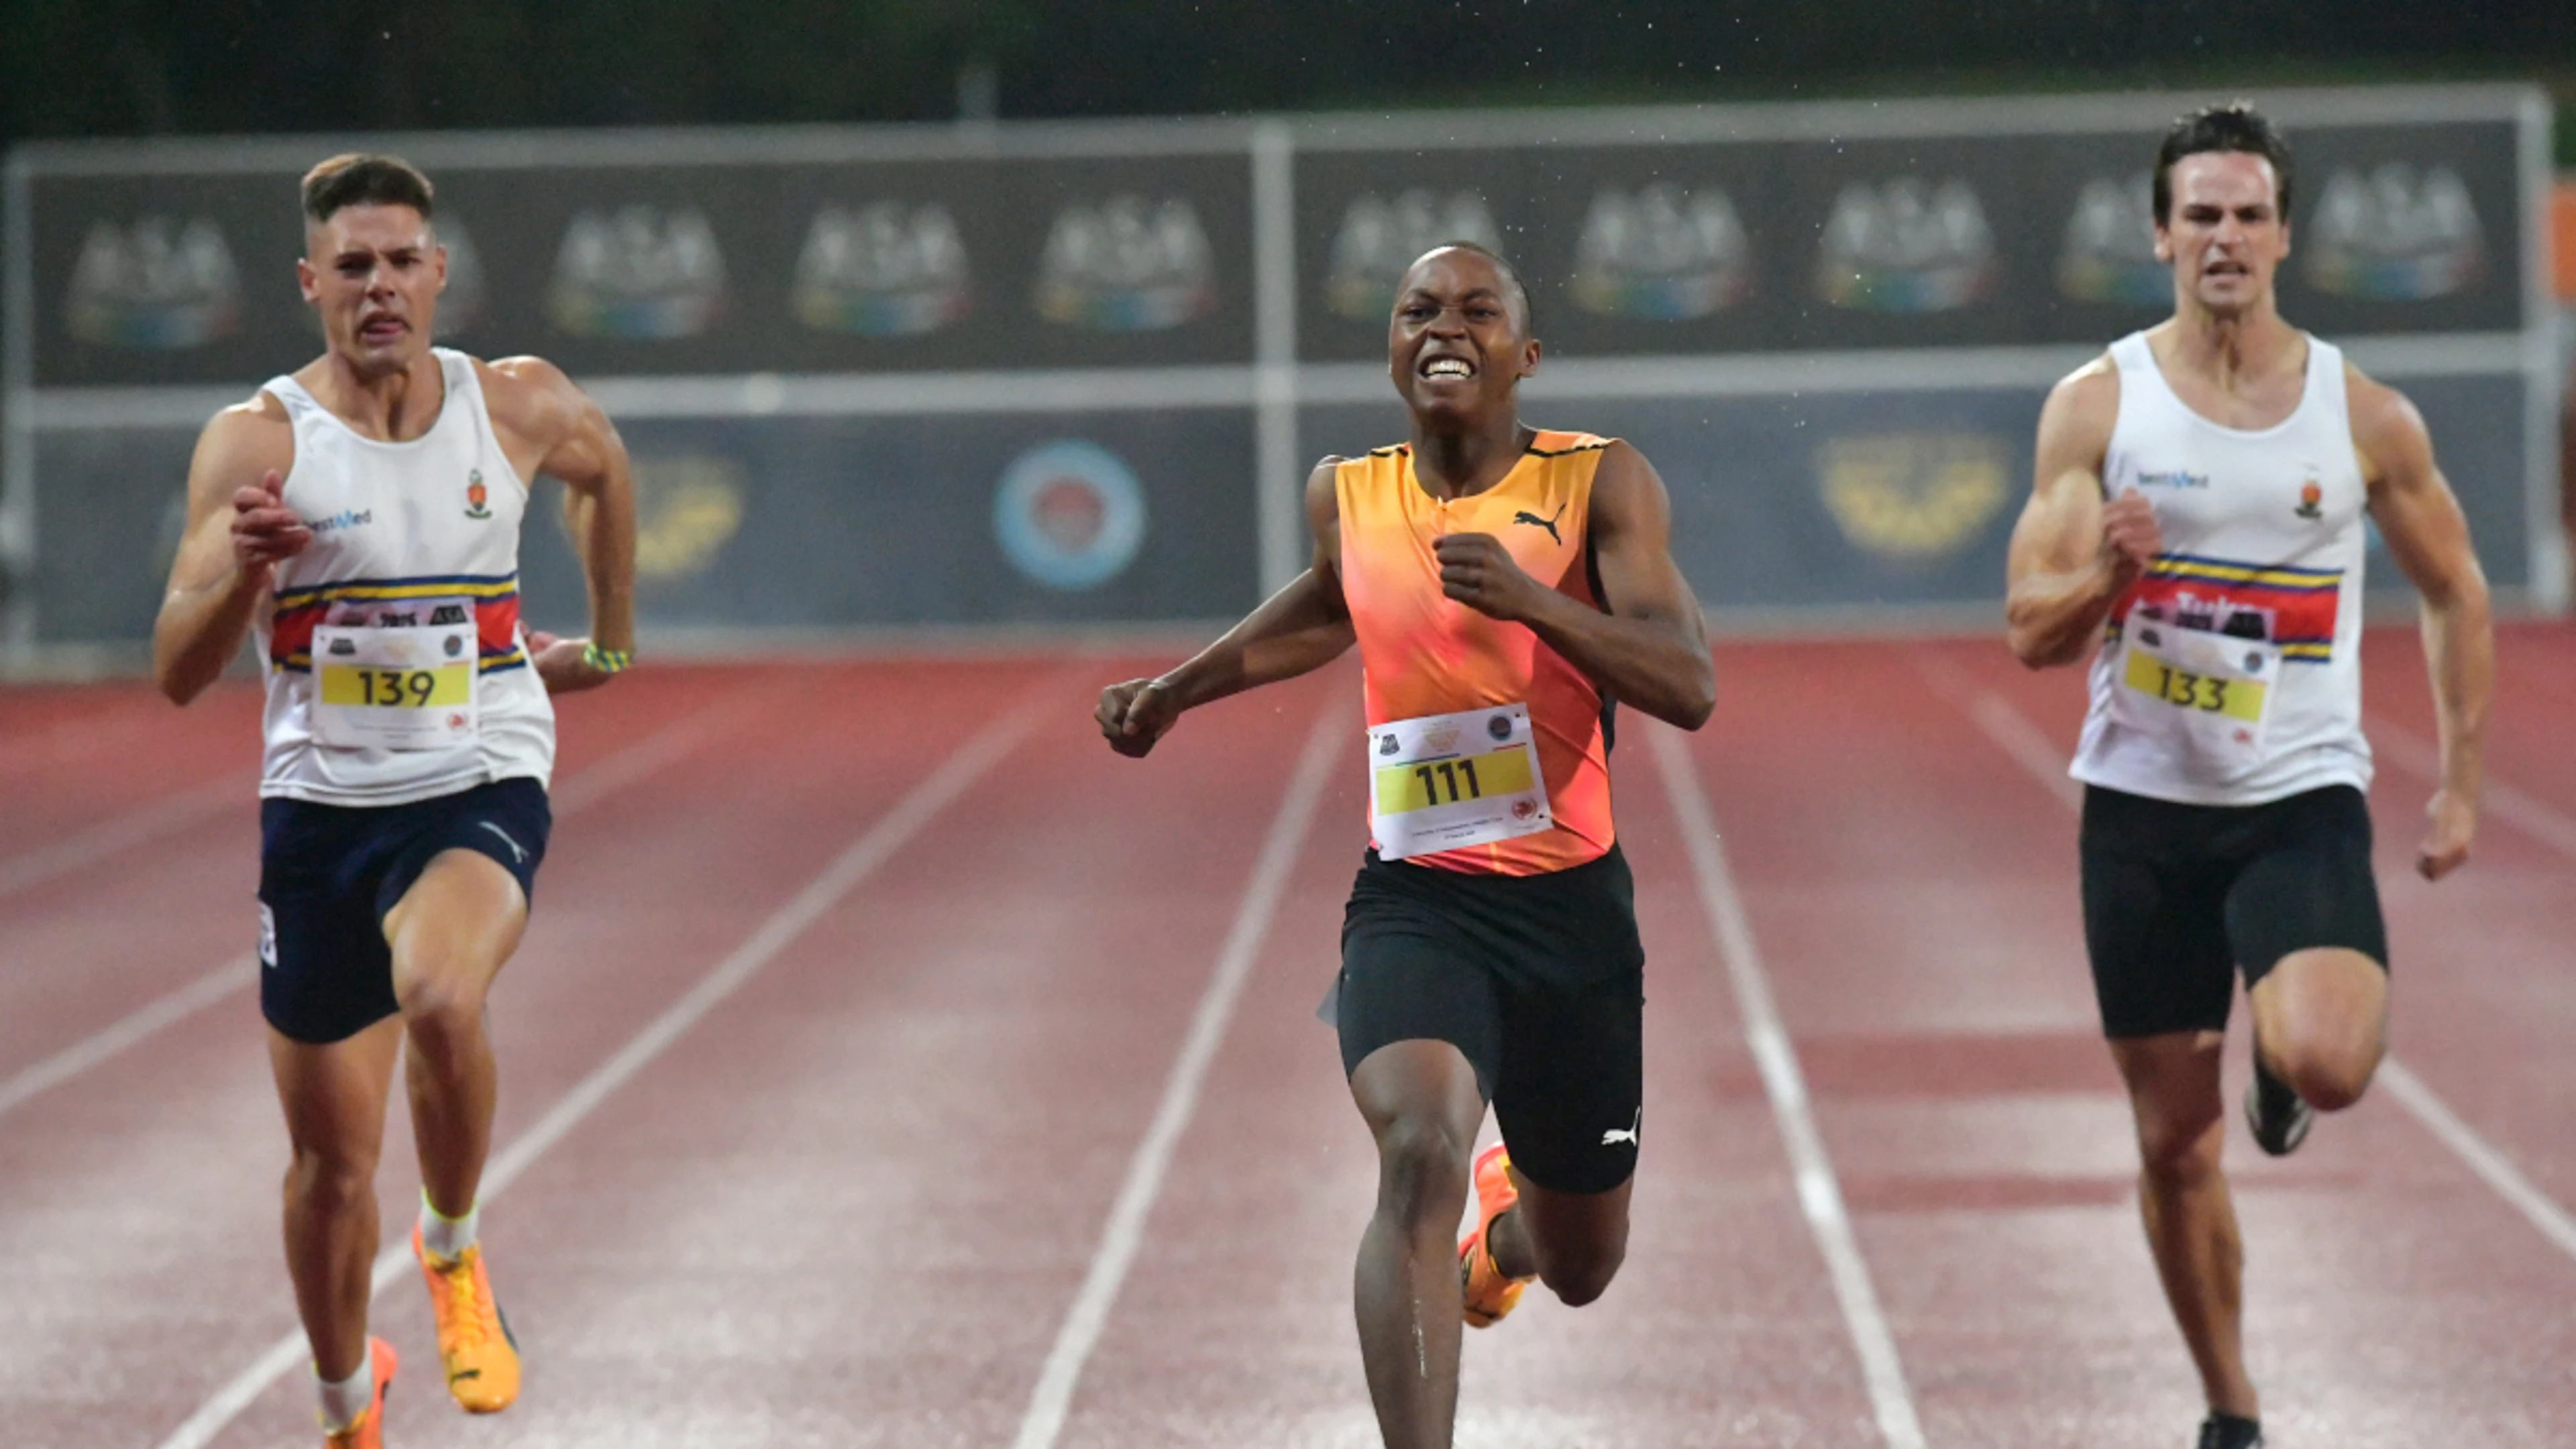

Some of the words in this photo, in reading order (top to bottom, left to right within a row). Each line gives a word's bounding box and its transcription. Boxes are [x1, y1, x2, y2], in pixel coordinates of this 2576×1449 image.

[305, 508, 371, 532] estMed
[358, 672, 435, 707] 139
[2159, 667, 2229, 712] 133
[1416, 759, 1480, 806] 111
